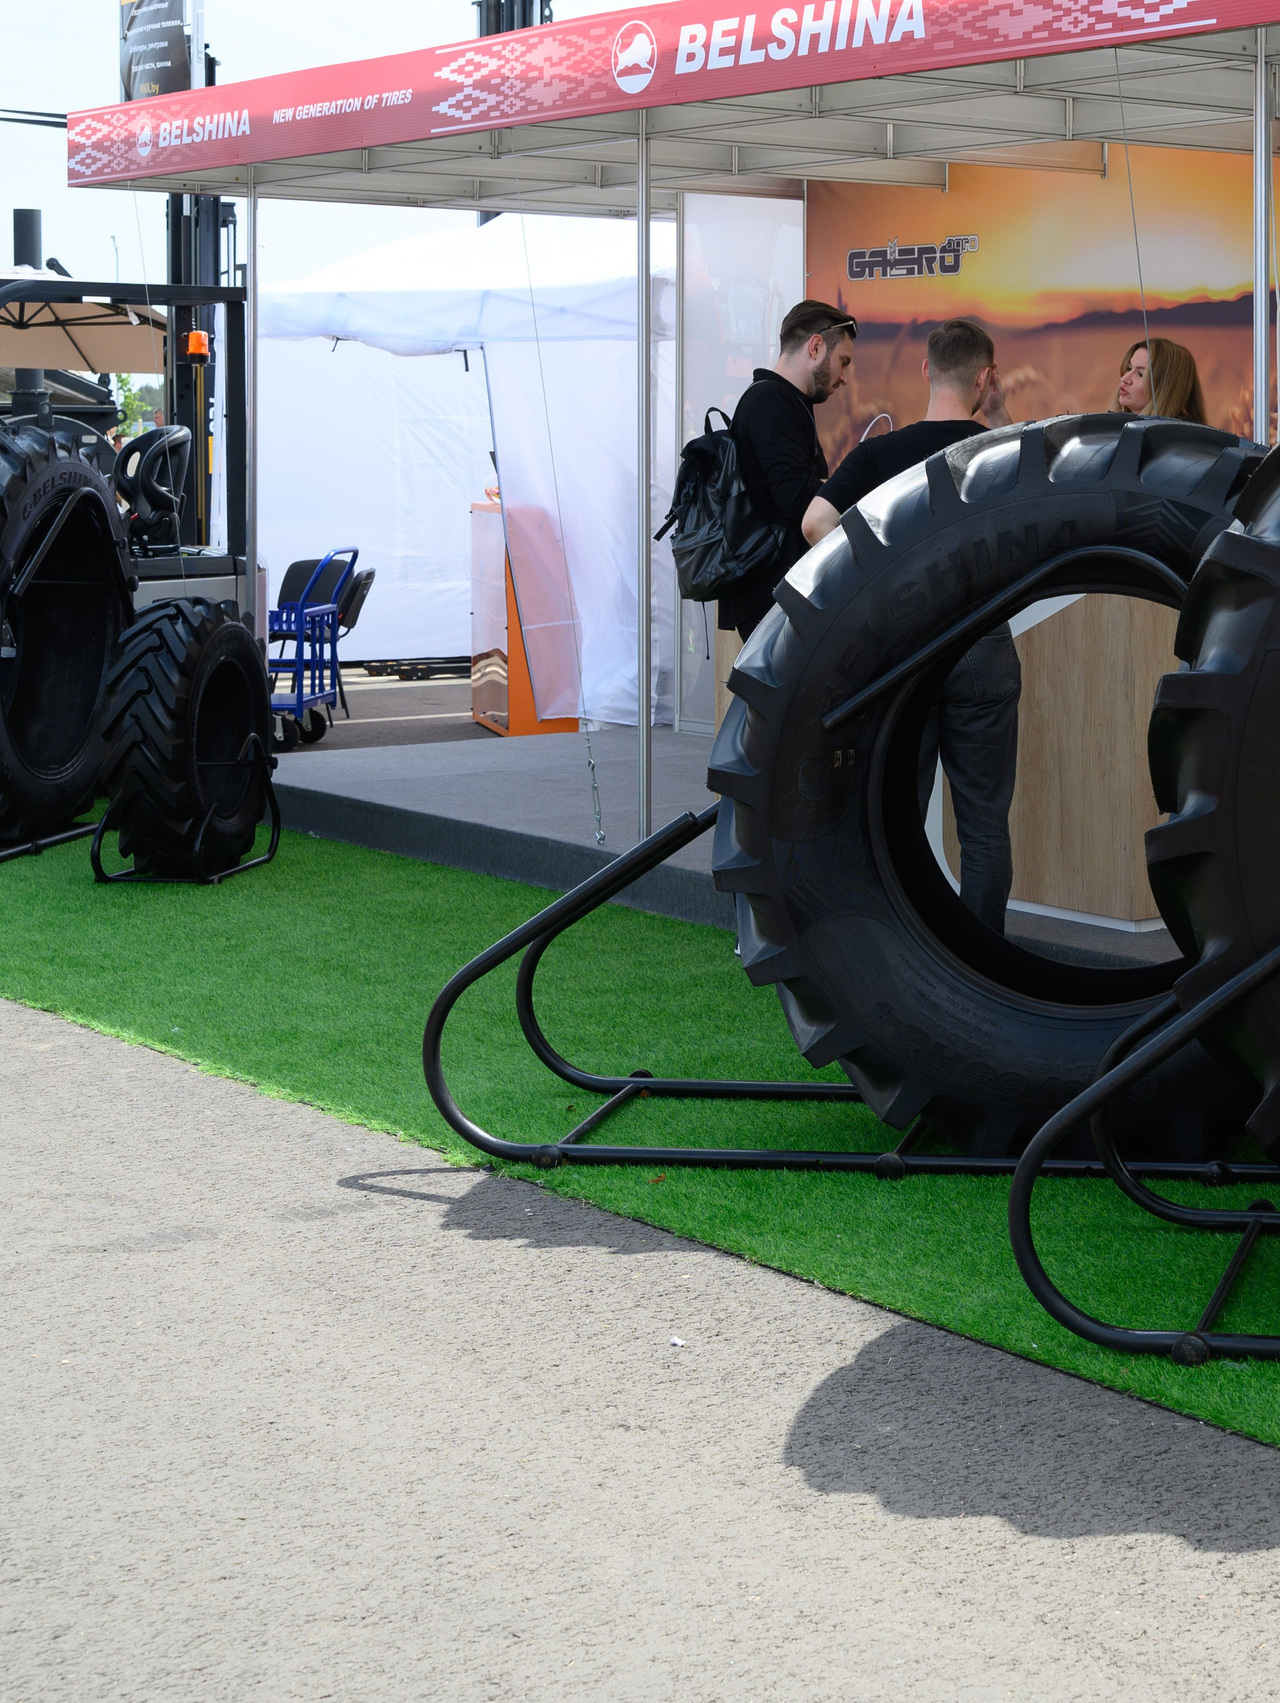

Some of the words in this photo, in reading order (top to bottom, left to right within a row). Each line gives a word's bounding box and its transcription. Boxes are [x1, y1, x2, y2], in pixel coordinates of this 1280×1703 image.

[675, 0, 926, 75] BELSHINA
[159, 109, 250, 148] BELSHINA
[273, 107, 295, 125] NEW
[296, 97, 362, 121] GENERATION
[363, 94, 380, 110] OF
[382, 89, 413, 107] TIRES
[918, 1010, 991, 1058] RADIAL
